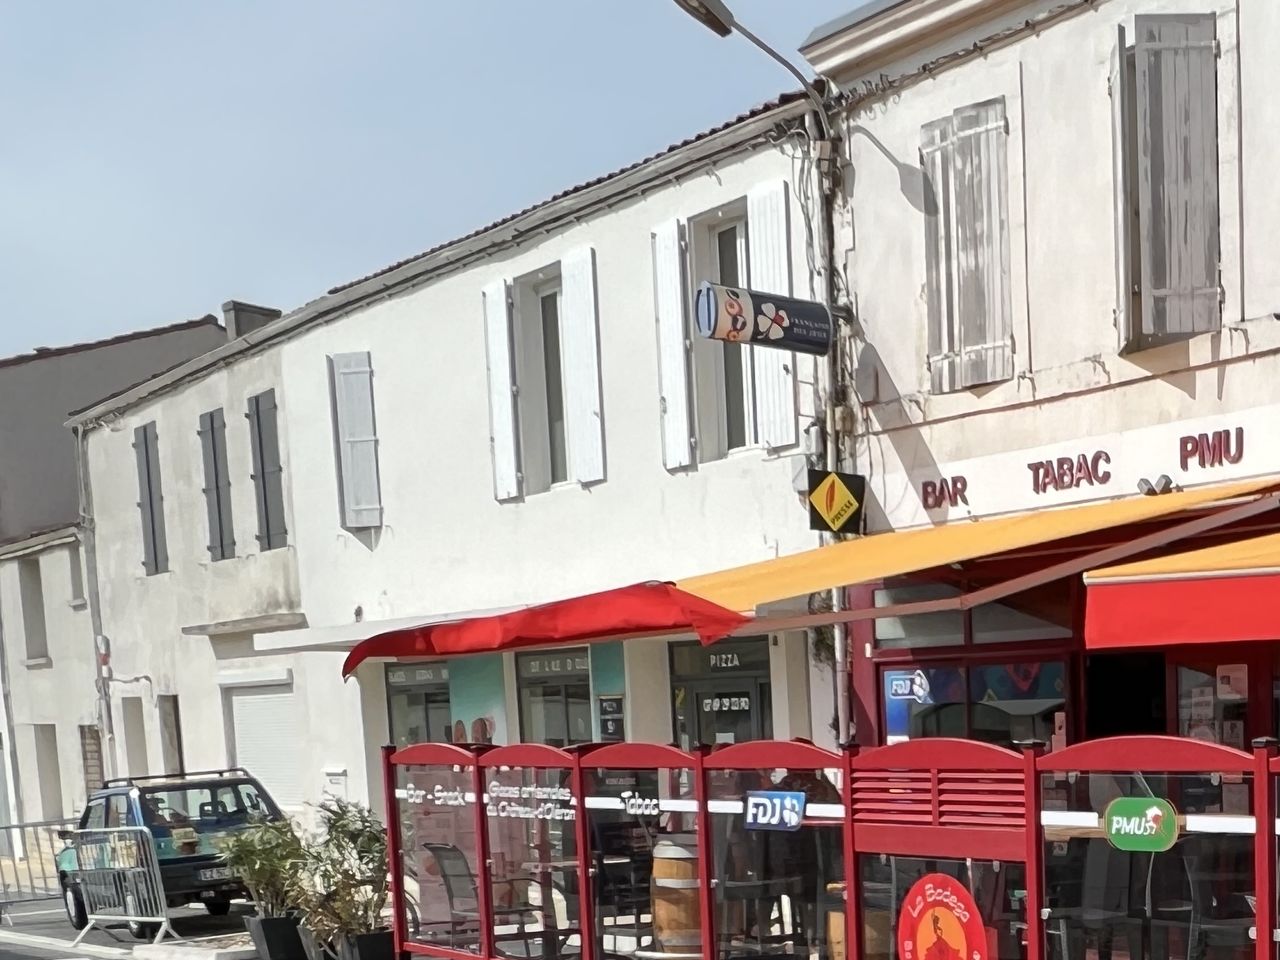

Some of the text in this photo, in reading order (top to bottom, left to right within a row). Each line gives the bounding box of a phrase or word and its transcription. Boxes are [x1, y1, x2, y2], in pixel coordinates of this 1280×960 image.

[921, 427, 1244, 510] BAR TABAC PMU
[710, 654, 740, 667] PIZZA
[620, 791, 659, 815] Tabac
[746, 796, 782, 824] FDJ
[1111, 815, 1146, 835] PMU
[908, 895, 925, 918] La
